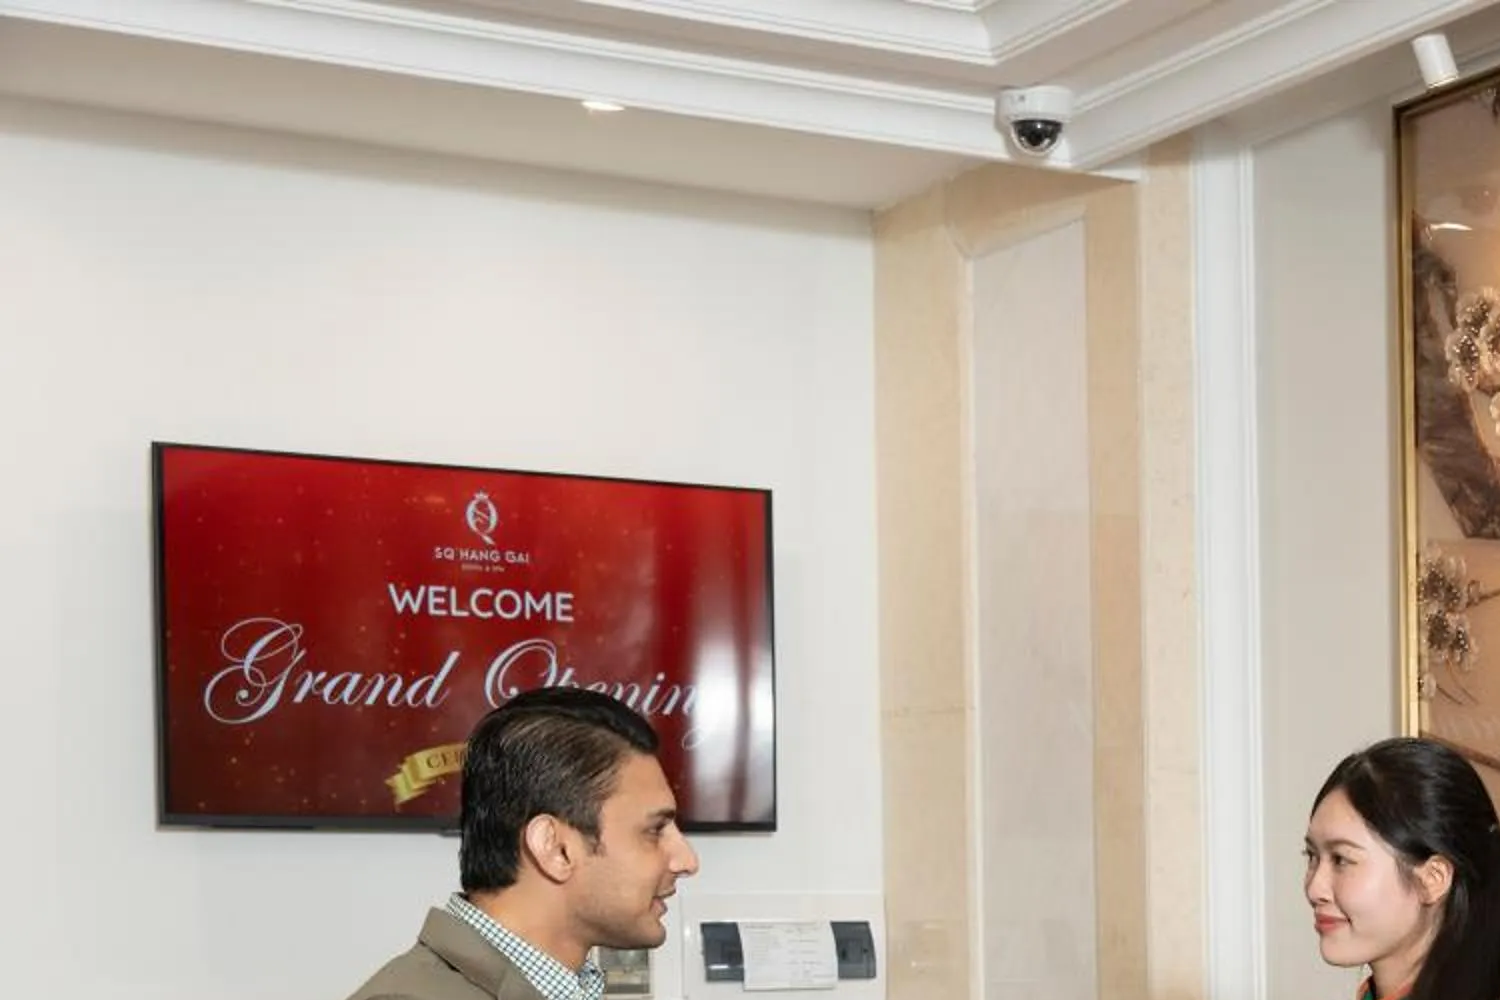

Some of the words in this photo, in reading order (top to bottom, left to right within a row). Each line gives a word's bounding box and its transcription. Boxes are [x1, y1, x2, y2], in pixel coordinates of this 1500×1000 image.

[459, 548, 501, 563] HANG
[388, 583, 575, 623] WELCOME
[203, 617, 461, 724] Grand
